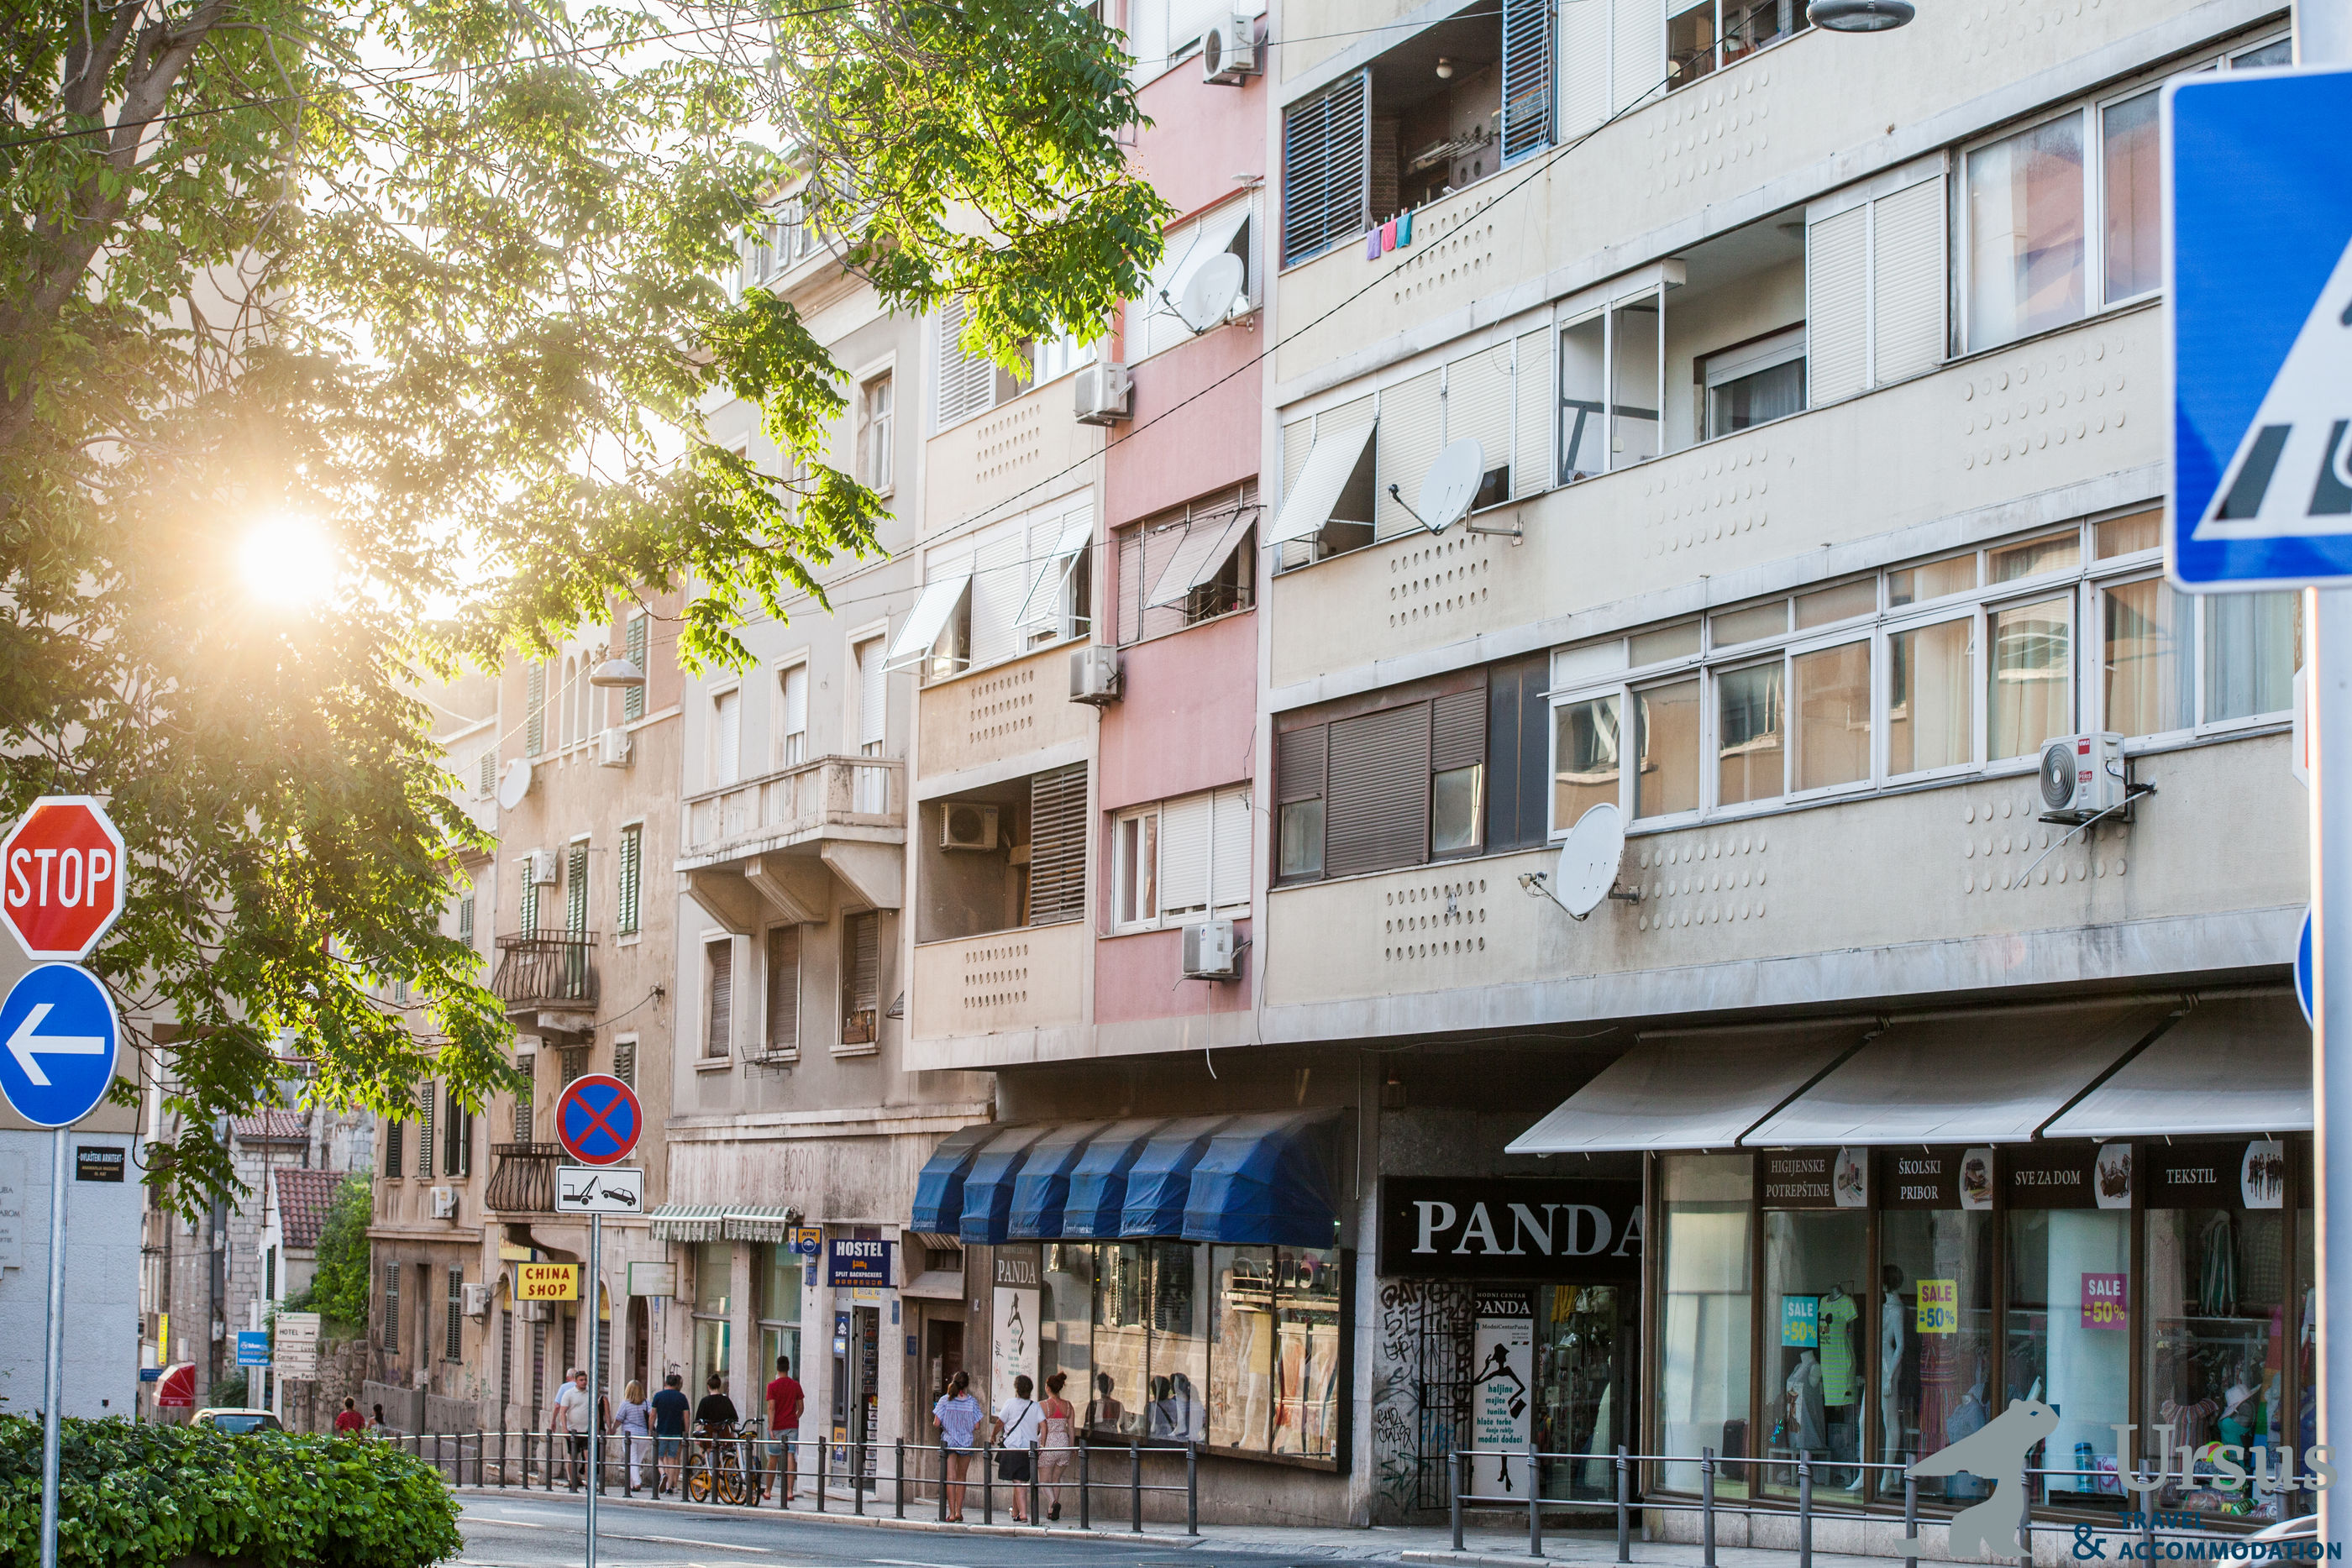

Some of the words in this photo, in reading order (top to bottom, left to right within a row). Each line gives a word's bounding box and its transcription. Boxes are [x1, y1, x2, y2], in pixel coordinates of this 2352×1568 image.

[8, 847, 113, 908] STOP
[1771, 1159, 1825, 1177] HIGIJENSKE
[1898, 1156, 1941, 1175] ŠKOLSKI
[2015, 1171, 2035, 1186] SVE
[2037, 1171, 2052, 1185] ZA
[2054, 1170, 2081, 1185] DOM
[2166, 1168, 2218, 1184] TEKSTIL
[1766, 1181, 1830, 1198] POTREPŠTINE
[1900, 1185, 1939, 1200] PRIBOR
[1411, 1200, 1643, 1256] PANDA
[836, 1241, 884, 1256] HOSTEL
[525, 1267, 570, 1280] CHINA
[997, 1259, 1037, 1284] PANDA
[528, 1283, 567, 1296] SHOP
[1921, 1285, 1952, 1303] SALE
[2087, 1279, 2122, 1297] SALE
[1475, 1300, 1531, 1314] PANDA
[1788, 1302, 1814, 1318] SALE
[279, 1328, 299, 1336] HOTEL
[1488, 1383, 1513, 1395] haljine
[1485, 1397, 1505, 1406] majice
[1478, 1434, 1499, 1444] modni
[1501, 1434, 1523, 1444] dodaci
[1499, 1427, 1514, 1435] rublje
